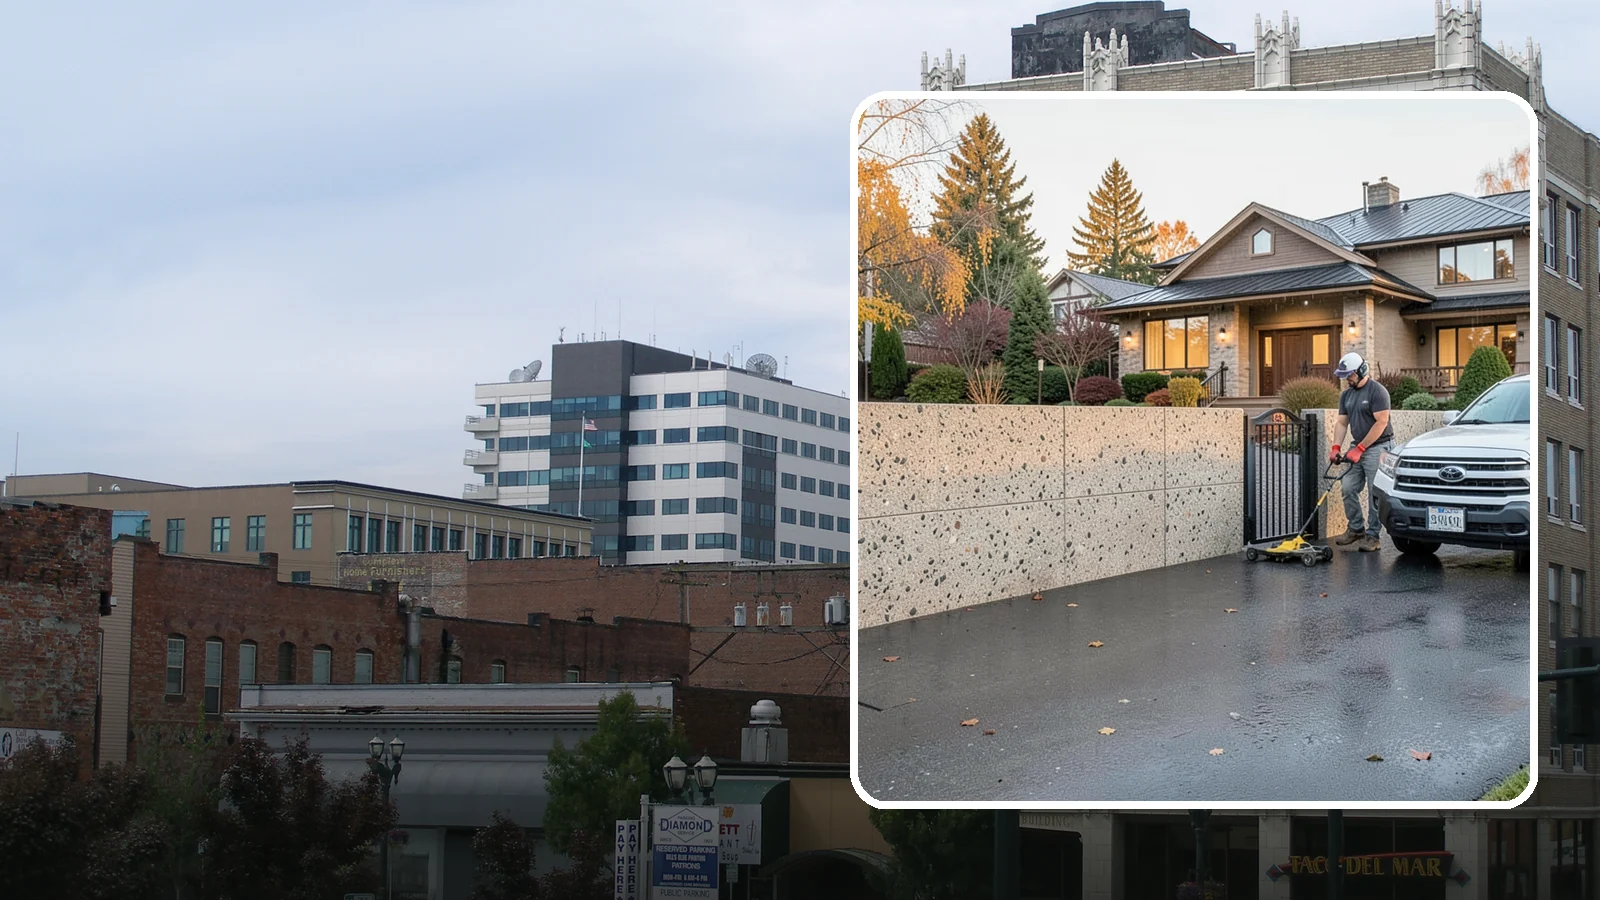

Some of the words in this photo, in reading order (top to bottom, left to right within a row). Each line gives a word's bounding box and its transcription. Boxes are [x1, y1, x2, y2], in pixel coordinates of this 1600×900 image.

[343, 567, 367, 577] Home
[370, 566, 426, 576] Furnishers
[660, 818, 713, 833] DIAMOND
[1022, 815, 1070, 827] BUILDING
[617, 825, 625, 852] PAY
[628, 824, 636, 852] PAY
[656, 845, 688, 853] RESERVED
[689, 846, 716, 854] PARKING
[721, 851, 739, 862] Soup
[1288, 856, 1330, 874] TAC
[1345, 856, 1385, 875] DEL
[1393, 857, 1442, 877] MAR
[616, 856, 625, 893] HERE
[627, 856, 636, 893] HERE
[660, 888, 682, 897] PUBLIC
[683, 889, 710, 898] PARKING
